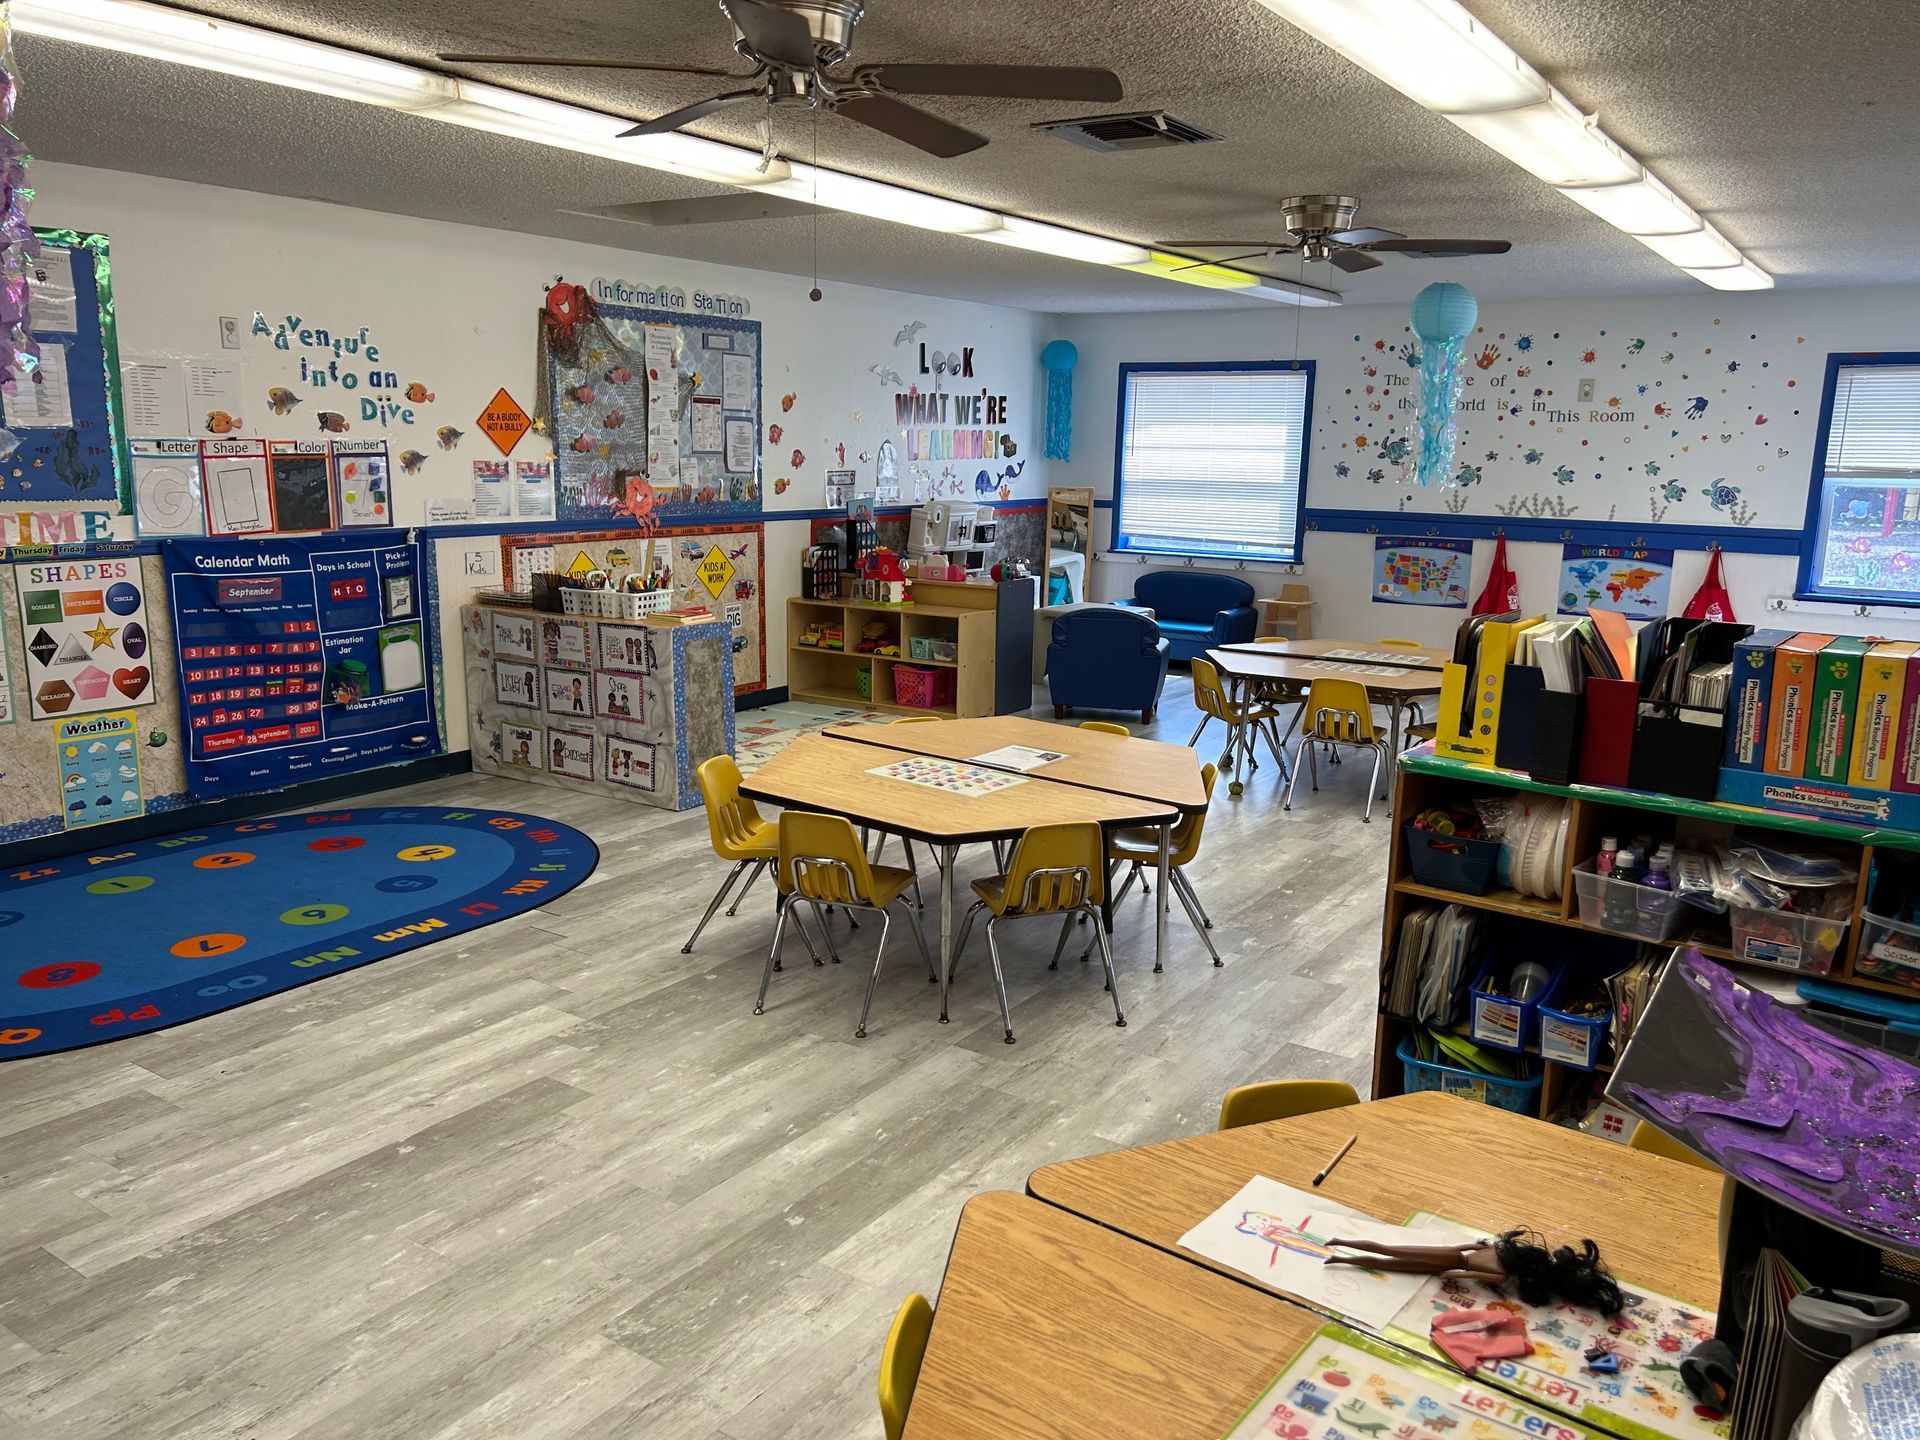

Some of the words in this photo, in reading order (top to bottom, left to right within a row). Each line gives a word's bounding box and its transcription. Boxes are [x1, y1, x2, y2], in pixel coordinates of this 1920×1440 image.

[598, 280, 684, 308] Information
[250, 311, 379, 362] Adventure
[300, 356, 358, 390] into
[369, 370, 398, 389] an
[1384, 374, 1410, 386] The
[1490, 374, 1508, 386] of
[360, 396, 415, 428] Dive
[895, 393, 949, 425] WHAT
[954, 388, 1007, 425] WE'RE
[1456, 398, 1485, 411] orld
[1497, 398, 1510, 411] is
[1532, 399, 1546, 412] in
[487, 412, 497, 421] BE
[497, 413, 501, 421] A
[502, 412, 521, 421] BUDDY
[1549, 410, 1580, 423] This
[1589, 410, 1635, 422] Room
[487, 423, 499, 431] NOT
[500, 423, 504, 431] A
[505, 423, 523, 431] BULLY
[161, 442, 197, 453] Letter
[213, 442, 249, 455] Shape
[299, 442, 326, 453] Color
[339, 441, 380, 451] Number
[907, 430, 1000, 461] LEARNING!
[139, 465, 194, 529] G
[14, 547, 53, 556] Thursday
[59, 546, 85, 554] Friday
[96, 544, 133, 552] Saturday
[1582, 548, 1620, 557] WORLD
[1624, 550, 1648, 559] MAP
[195, 555, 254, 568] Calendar
[257, 553, 291, 567] Math
[475, 552, 482, 562] 5
[30, 562, 127, 584] SHAPES
[316, 563, 336, 572] Days
[338, 561, 345, 570] in
[346, 560, 371, 569] School
[468, 563, 487, 575] Kids
[703, 562, 719, 573] KIDS
[720, 561, 727, 571] AT
[707, 573, 725, 583] WORK
[228, 587, 274, 598] September
[333, 588, 341, 596] H
[345, 586, 351, 595] T
[356, 585, 363, 593] O
[31, 603, 56, 611] SQUARE
[66, 599, 101, 607] RECTANGLE
[306, 622, 311, 630] 2
[30, 643, 57, 651] DIAMOND
[325, 636, 364, 647] Estimation
[190, 649, 196, 657] 3
[230, 647, 236, 655] 5
[250, 646, 256, 654] 6
[271, 644, 278, 652] 7
[293, 644, 299, 652] 8
[59, 655, 89, 663] TRIANGLE
[190, 672, 201, 680] 10
[229, 668, 240, 676] 12
[250, 667, 260, 675] 13
[270, 666, 280, 674] 14
[289, 665, 300, 673] 15
[122, 677, 142, 685] HEART
[40, 693, 70, 701] HEXAGON
[192, 695, 203, 703] 17
[211, 692, 221, 700] 18
[230, 690, 240, 698] 19
[289, 685, 300, 693] 22
[307, 684, 317, 692] 23
[1748, 680, 1758, 711] Phonics
[346, 696, 404, 711] Make-A-Pattern
[1787, 687, 1798, 718] Phonics
[1830, 691, 1842, 723] Phonics
[1875, 693, 1887, 726] Phonics
[196, 718, 206, 726] 24
[215, 715, 226, 723] 25
[232, 712, 242, 720] 26
[250, 709, 260, 717] 27
[289, 706, 299, 714] 29
[307, 702, 317, 710] 30
[66, 719, 125, 736] Weather
[1745, 712, 1754, 735] Reading
[207, 738, 236, 747] Thursday
[247, 735, 257, 744] 28
[258, 729, 289, 739] eptember
[300, 726, 316, 734] 2023
[1783, 719, 1792, 743] Reading
[1826, 724, 1836, 748] Reading
[1870, 726, 1880, 751] Reading
[1741, 736, 1751, 761] Program
[1780, 744, 1789, 769] Program
[1823, 749, 1833, 775] Program
[289, 762, 312, 770] Numbers
[1867, 752, 1877, 778] Program
[1800, 786, 1850, 798] SCHOLASTIC
[1765, 787, 1807, 801] Phonics
[1807, 794, 1840, 808] Reading
[1841, 799, 1875, 812] Program
[234, 822, 279, 832] Cc
[155, 835, 209, 848] Bb
[88, 852, 137, 866] Aa
[413, 848, 444, 857] 4
[212, 855, 241, 865] 2
[10, 867, 61, 881] Zz
[373, 918, 449, 942] Mm
[200, 939, 224, 953] 7
[290, 945, 362, 968] Nn
[197, 975, 268, 997] Oo
[90, 1004, 161, 1026] Pp
[1294, 1378, 1317, 1393] Hh
[1476, 1357, 1580, 1406] Letter
[1417, 1395, 1439, 1410] Cc
[1271, 1403, 1296, 1419] Oo
[1460, 1387, 1577, 1440] Letters
